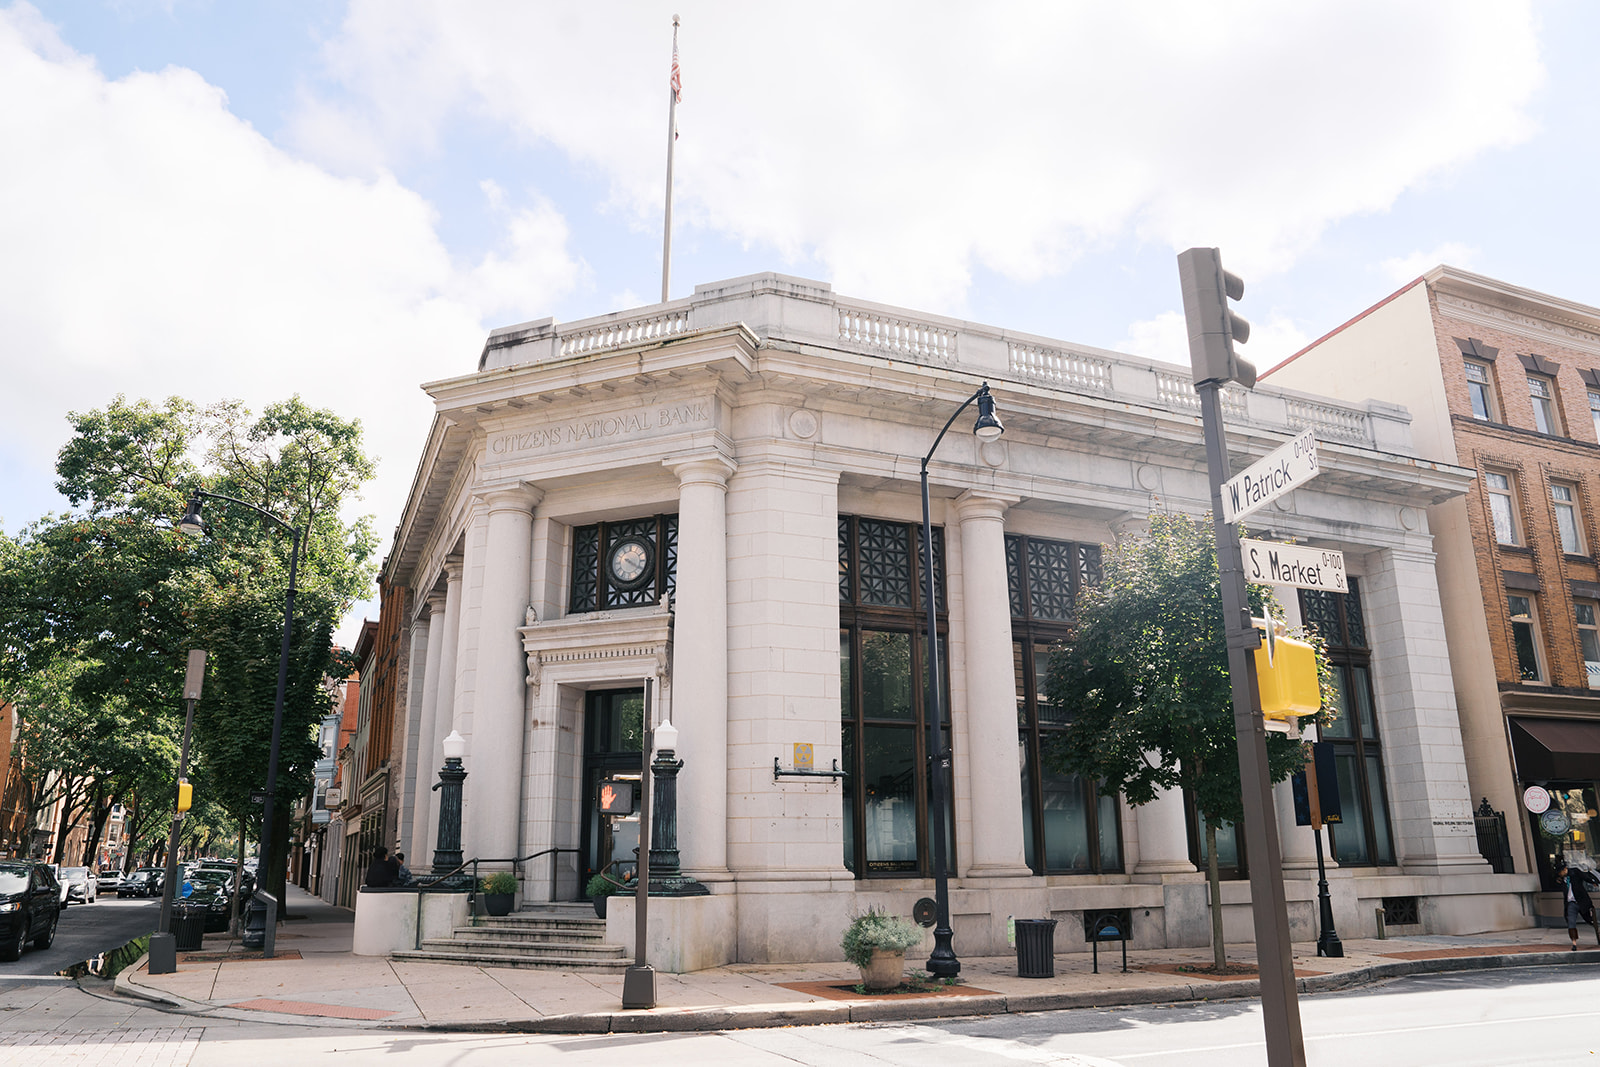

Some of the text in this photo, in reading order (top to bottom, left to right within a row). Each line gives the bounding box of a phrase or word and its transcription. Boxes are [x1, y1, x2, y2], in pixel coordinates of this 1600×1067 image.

[492, 404, 708, 455] CITIZENS NATIONAL BANK
[1293, 432, 1315, 458] 0-100
[1229, 453, 1318, 514] W. Patrick St
[1250, 548, 1345, 590] S. Market St
[1322, 552, 1342, 570] 0-100
[628, 729, 634, 740] 2
